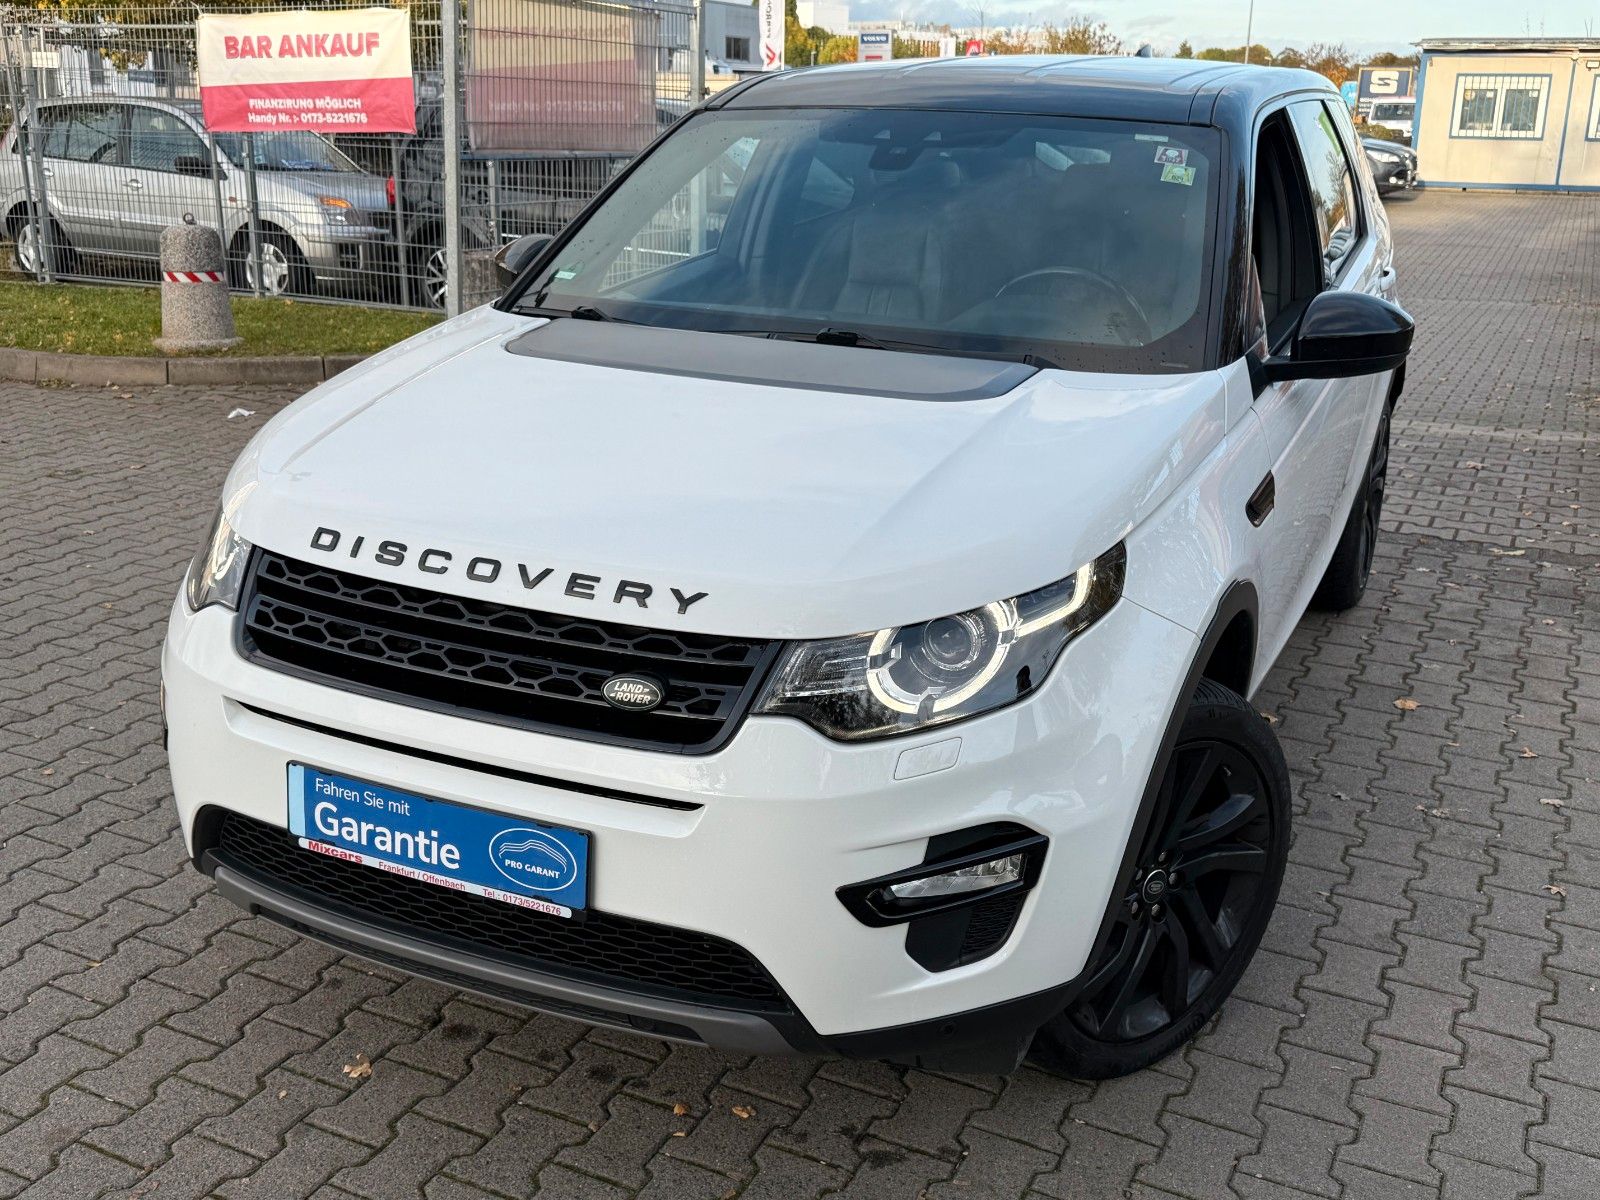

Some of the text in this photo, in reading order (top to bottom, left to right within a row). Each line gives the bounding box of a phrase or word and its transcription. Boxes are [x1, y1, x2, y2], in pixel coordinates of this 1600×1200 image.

[224, 32, 380, 59] BAR ANKAUF
[249, 95, 361, 109] FINANZIRUNG MÖGLICH
[248, 113, 277, 125] Handy
[310, 526, 709, 614] DISCOVERY
[614, 682, 644, 694] LAND
[615, 691, 651, 705] ROVER
[315, 778, 411, 816] Fahren Sie mit
[314, 801, 461, 870] Garantie
[308, 841, 363, 864] Mixcars
[378, 861, 416, 878] Frankfurt
[422, 873, 466, 891] Offenbach
[502, 893, 562, 916] 0173/5221676
[504, 859, 561, 879] PRO GARANT
